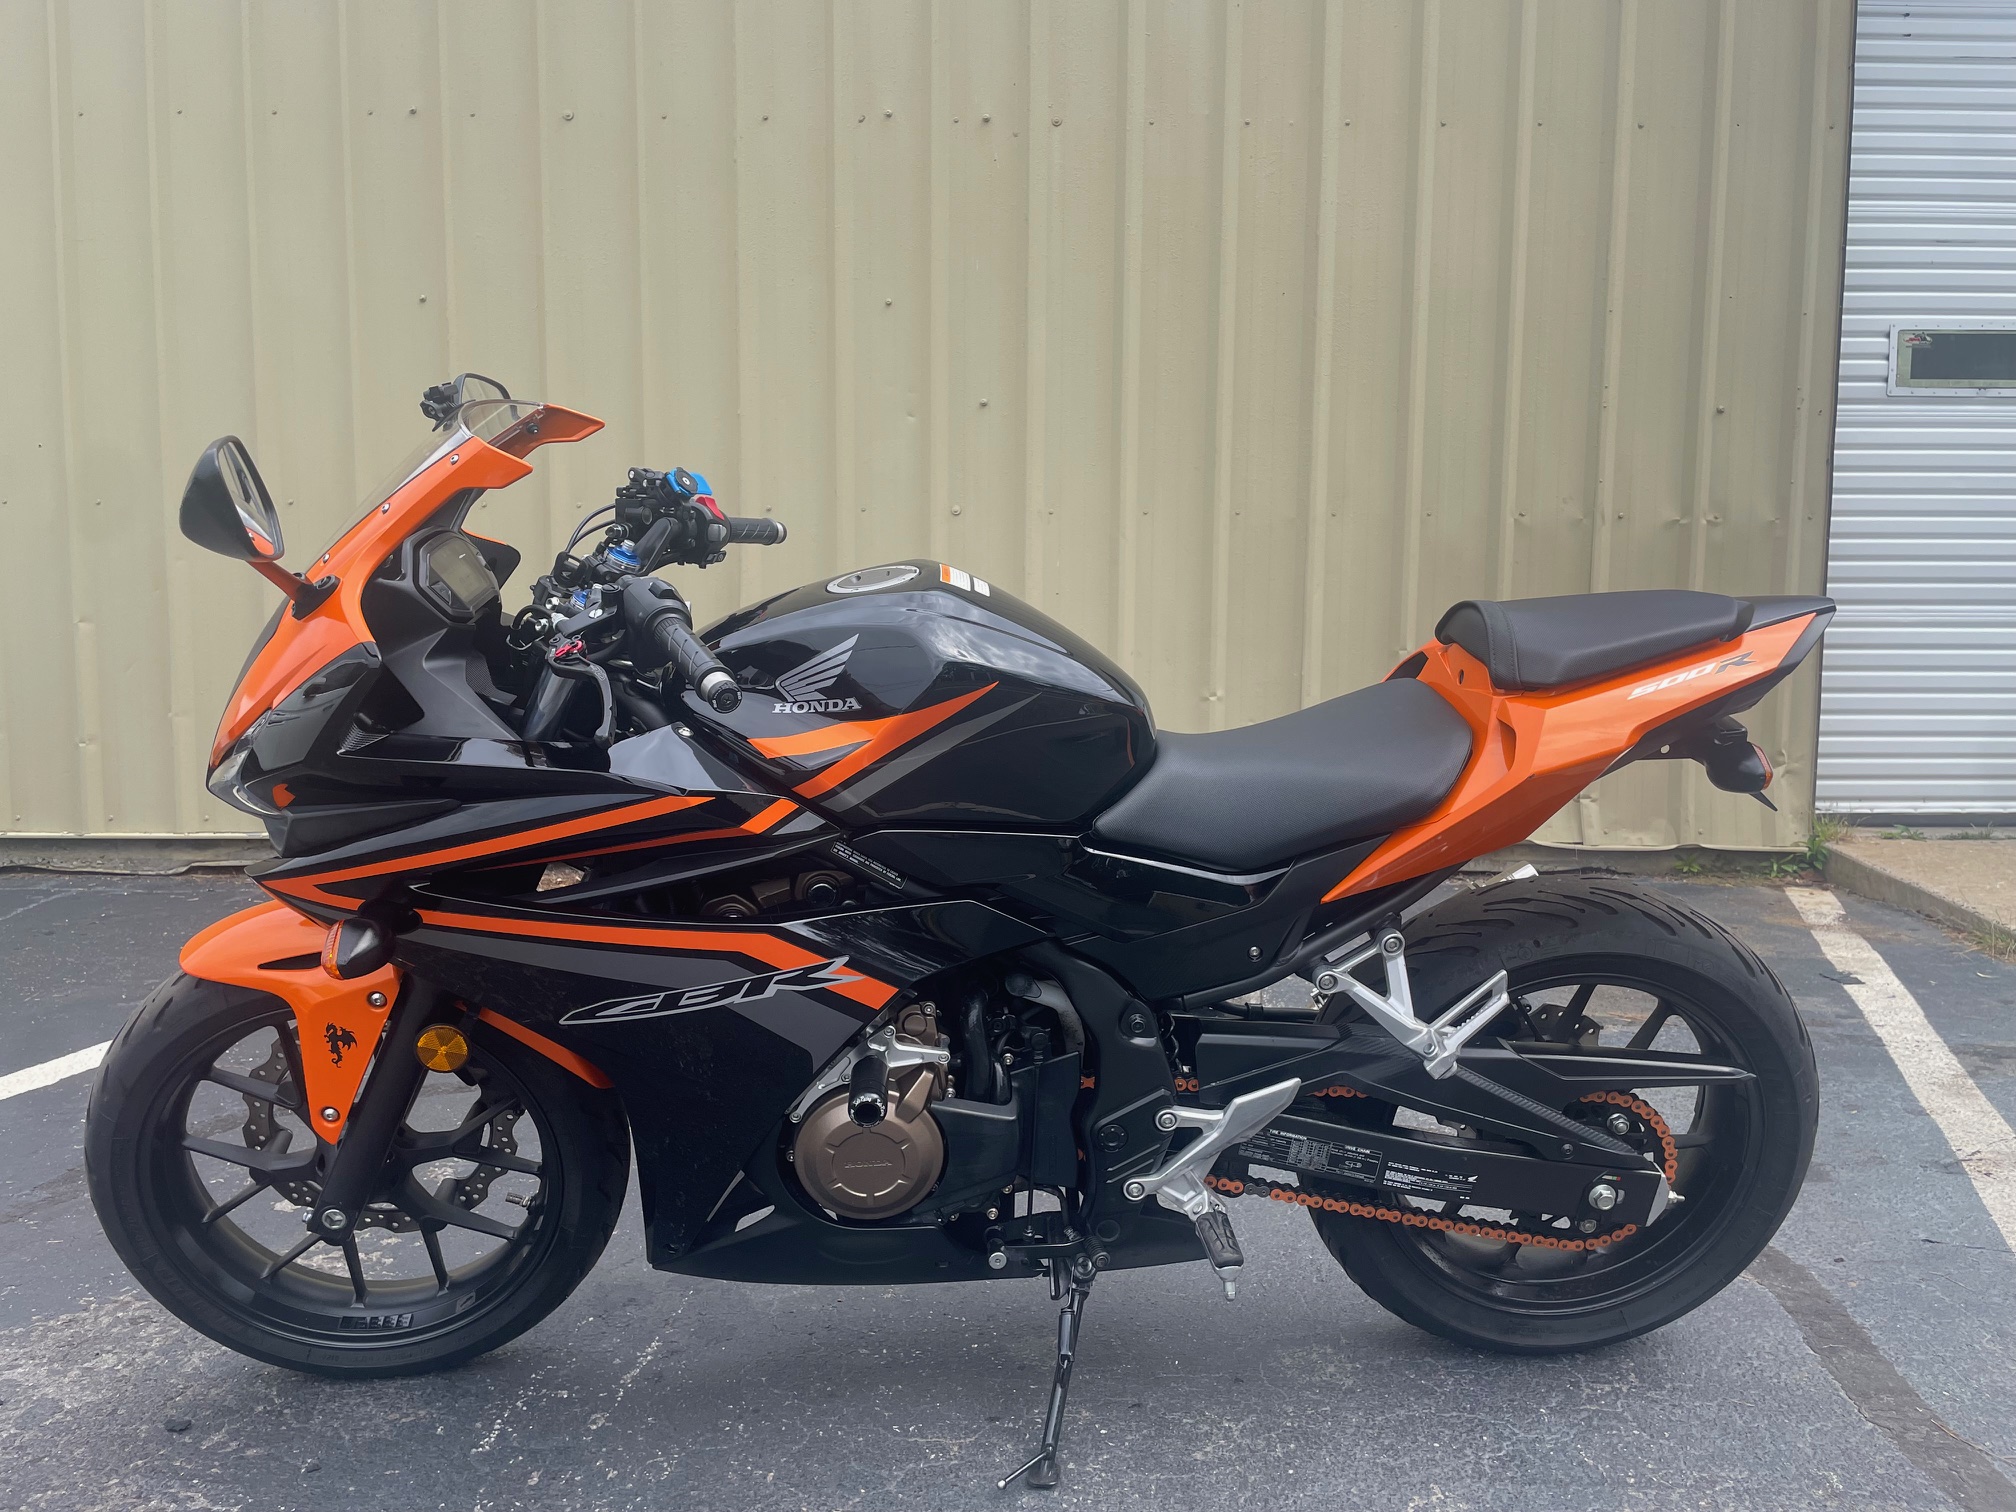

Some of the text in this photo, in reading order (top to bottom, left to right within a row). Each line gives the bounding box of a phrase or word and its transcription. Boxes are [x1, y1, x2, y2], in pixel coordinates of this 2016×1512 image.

[1627, 650, 1757, 700] 500R
[772, 697, 862, 714] HONDA
[558, 955, 866, 1026] CBR
[844, 1158, 893, 1170] HONDA
